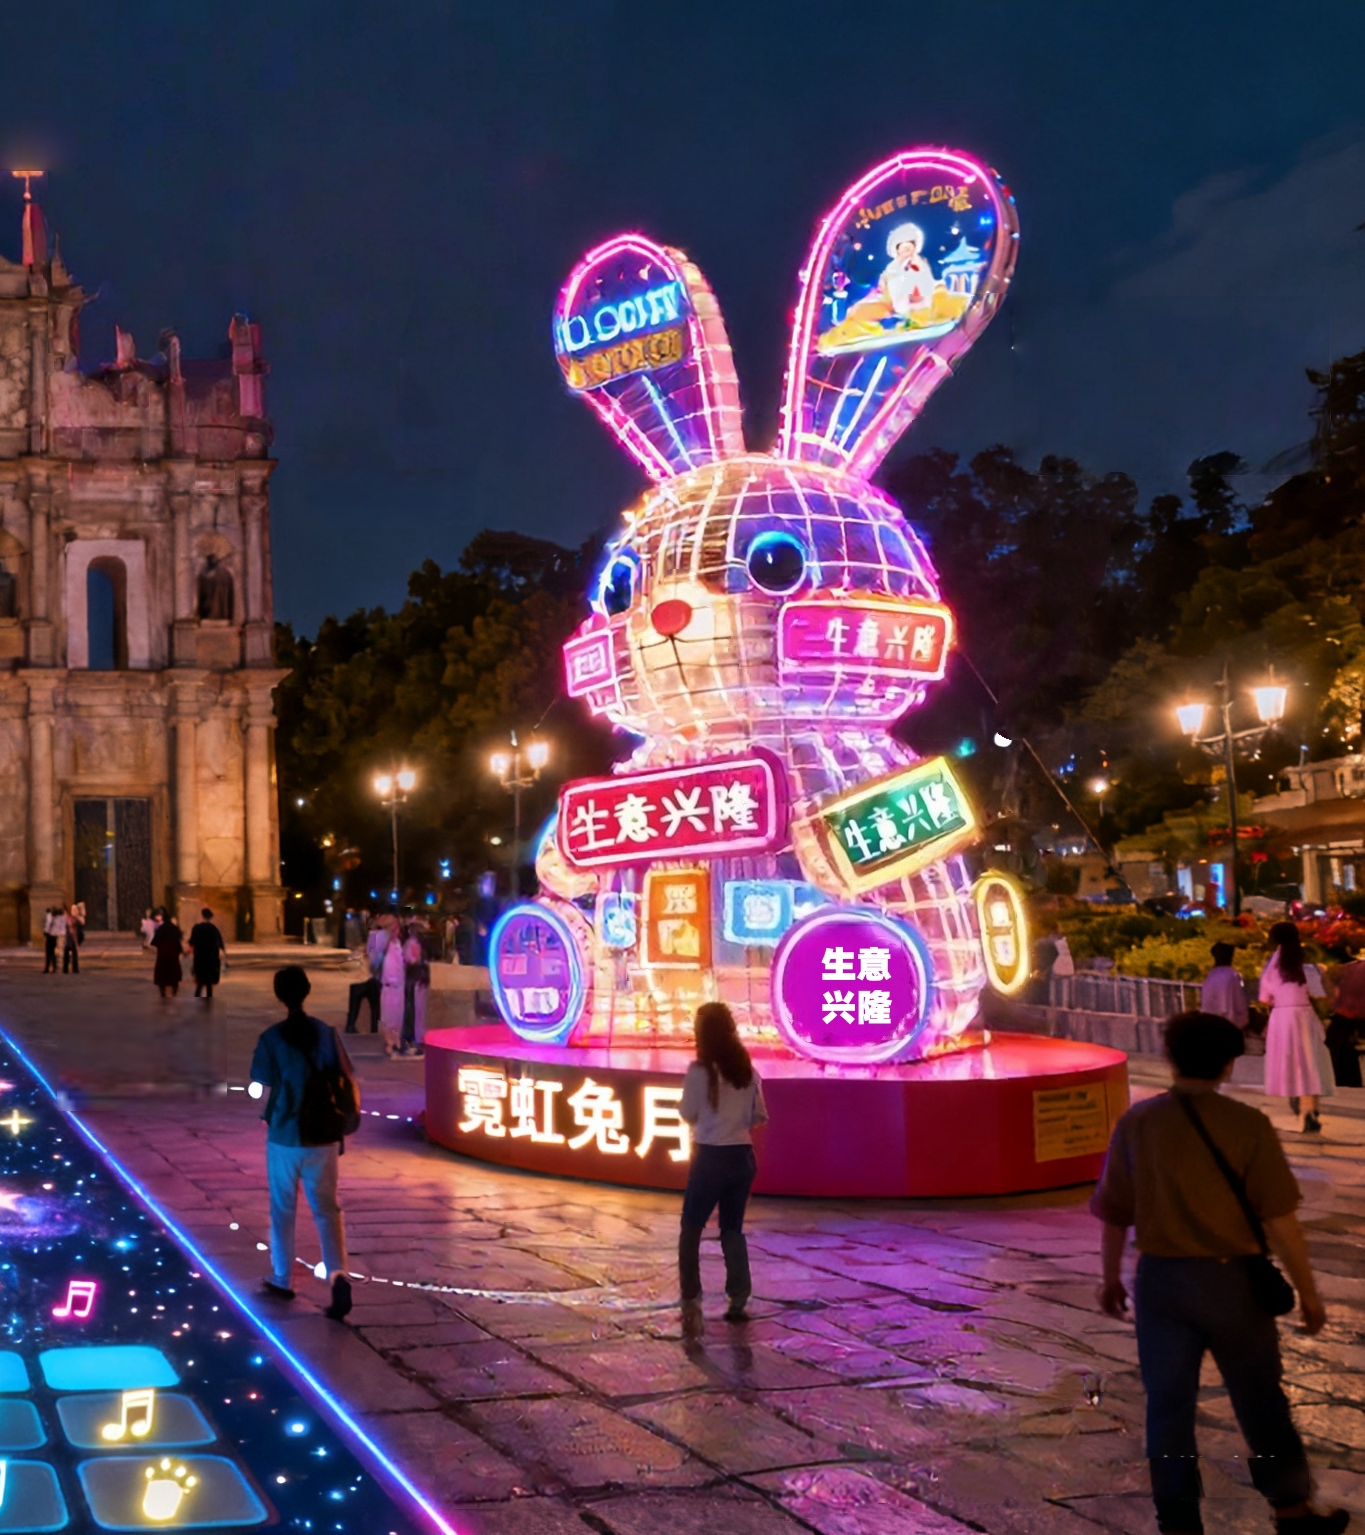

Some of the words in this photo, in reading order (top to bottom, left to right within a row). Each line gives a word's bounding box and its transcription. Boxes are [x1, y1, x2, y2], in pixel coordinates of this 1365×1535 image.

[569, 780, 759, 852] 生意兴隆
[821, 946, 892, 982] 生意
[821, 989, 893, 1025] 兴隆
